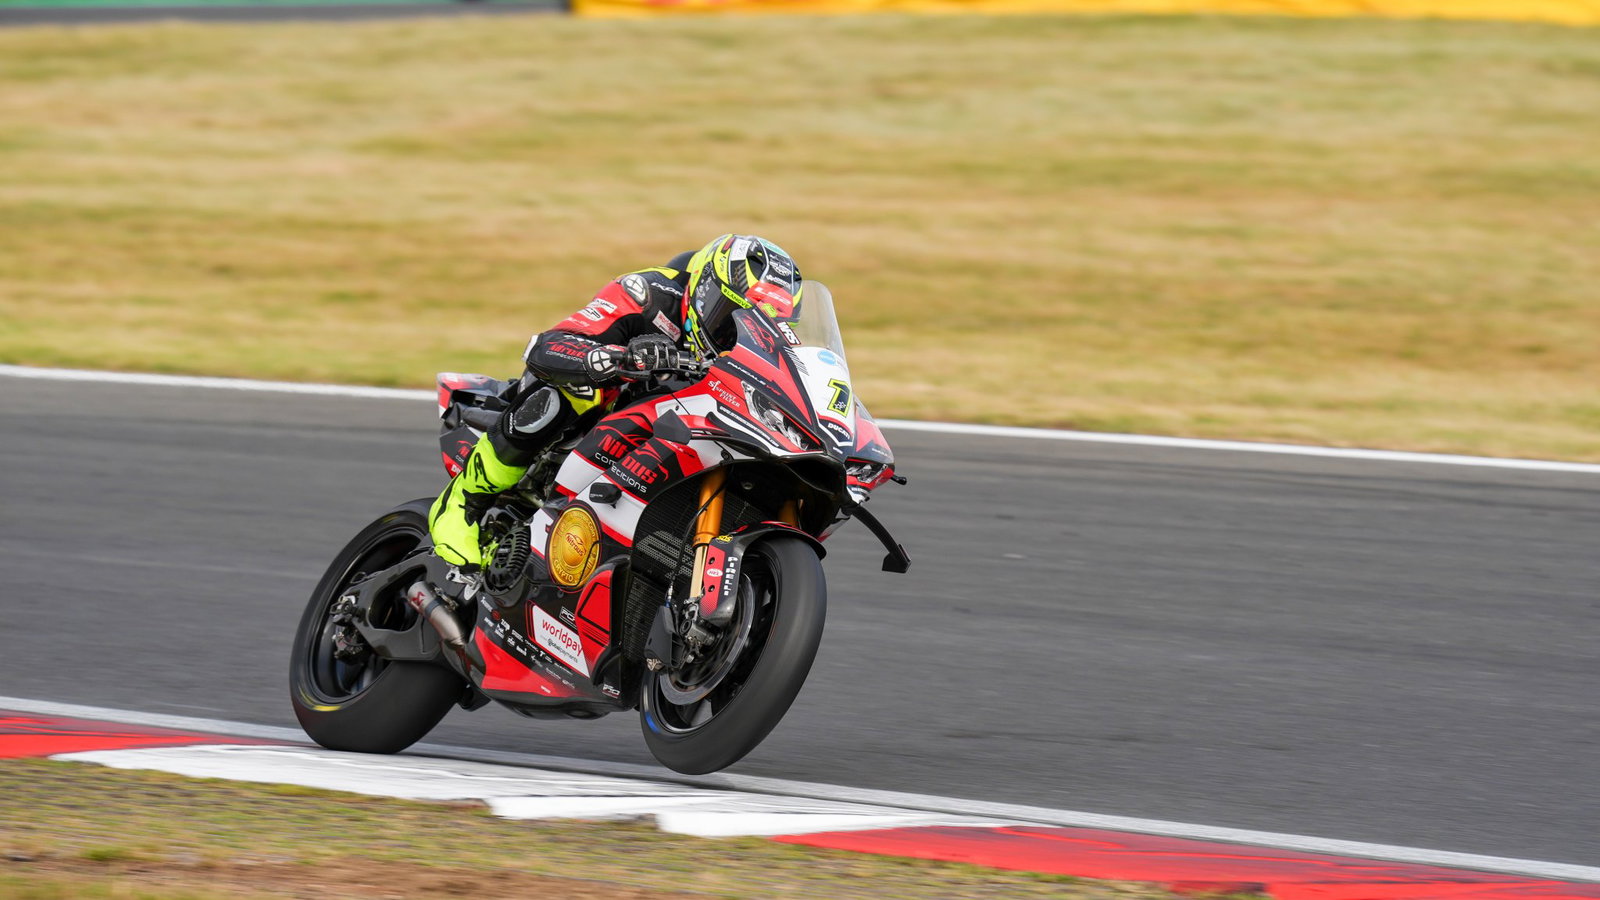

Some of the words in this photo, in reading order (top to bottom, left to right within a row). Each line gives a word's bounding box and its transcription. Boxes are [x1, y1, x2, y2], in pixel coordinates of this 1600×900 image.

[719, 392, 741, 408] FILTER
[827, 378, 851, 418] 1
[827, 422, 851, 440] DUCATI
[598, 433, 658, 484] Nitous
[553, 559, 574, 582] CRYPTO
[724, 557, 738, 596] PIRELLI
[542, 619, 583, 657] worldpay
